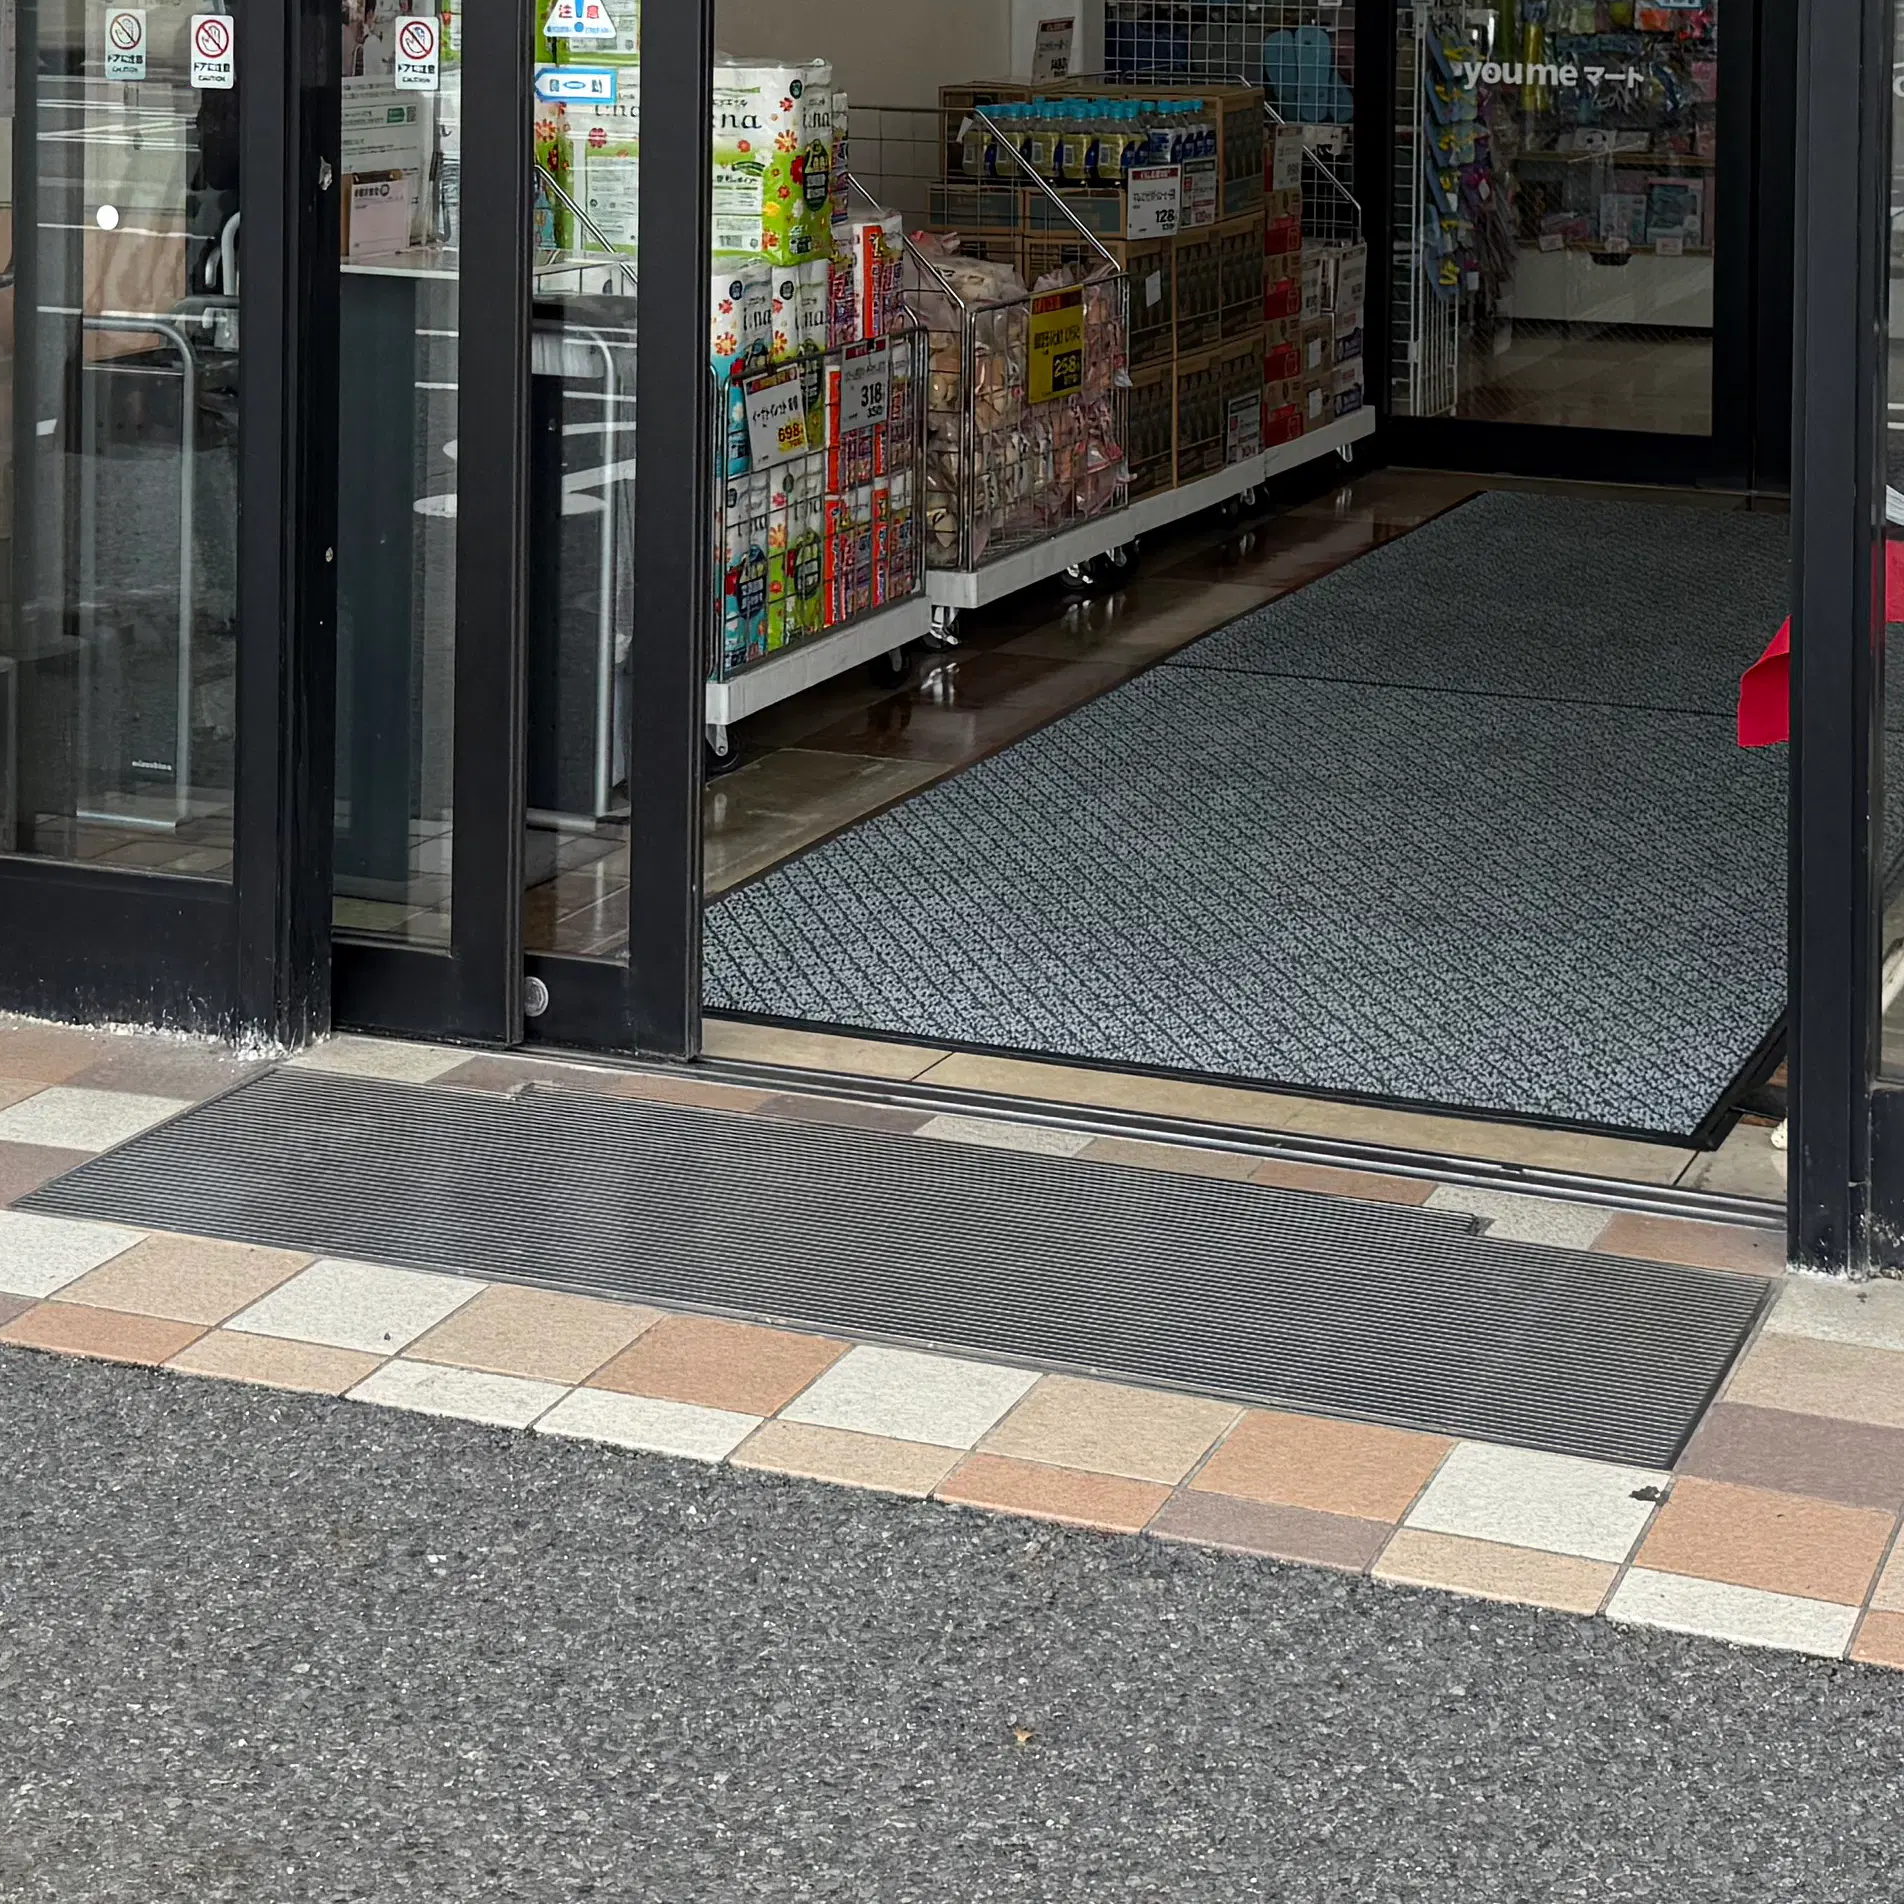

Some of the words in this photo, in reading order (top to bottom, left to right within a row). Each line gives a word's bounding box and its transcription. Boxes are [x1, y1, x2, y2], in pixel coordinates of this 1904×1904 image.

[1463, 62, 1578, 89] youme
[1583, 66, 1644, 88] マート
